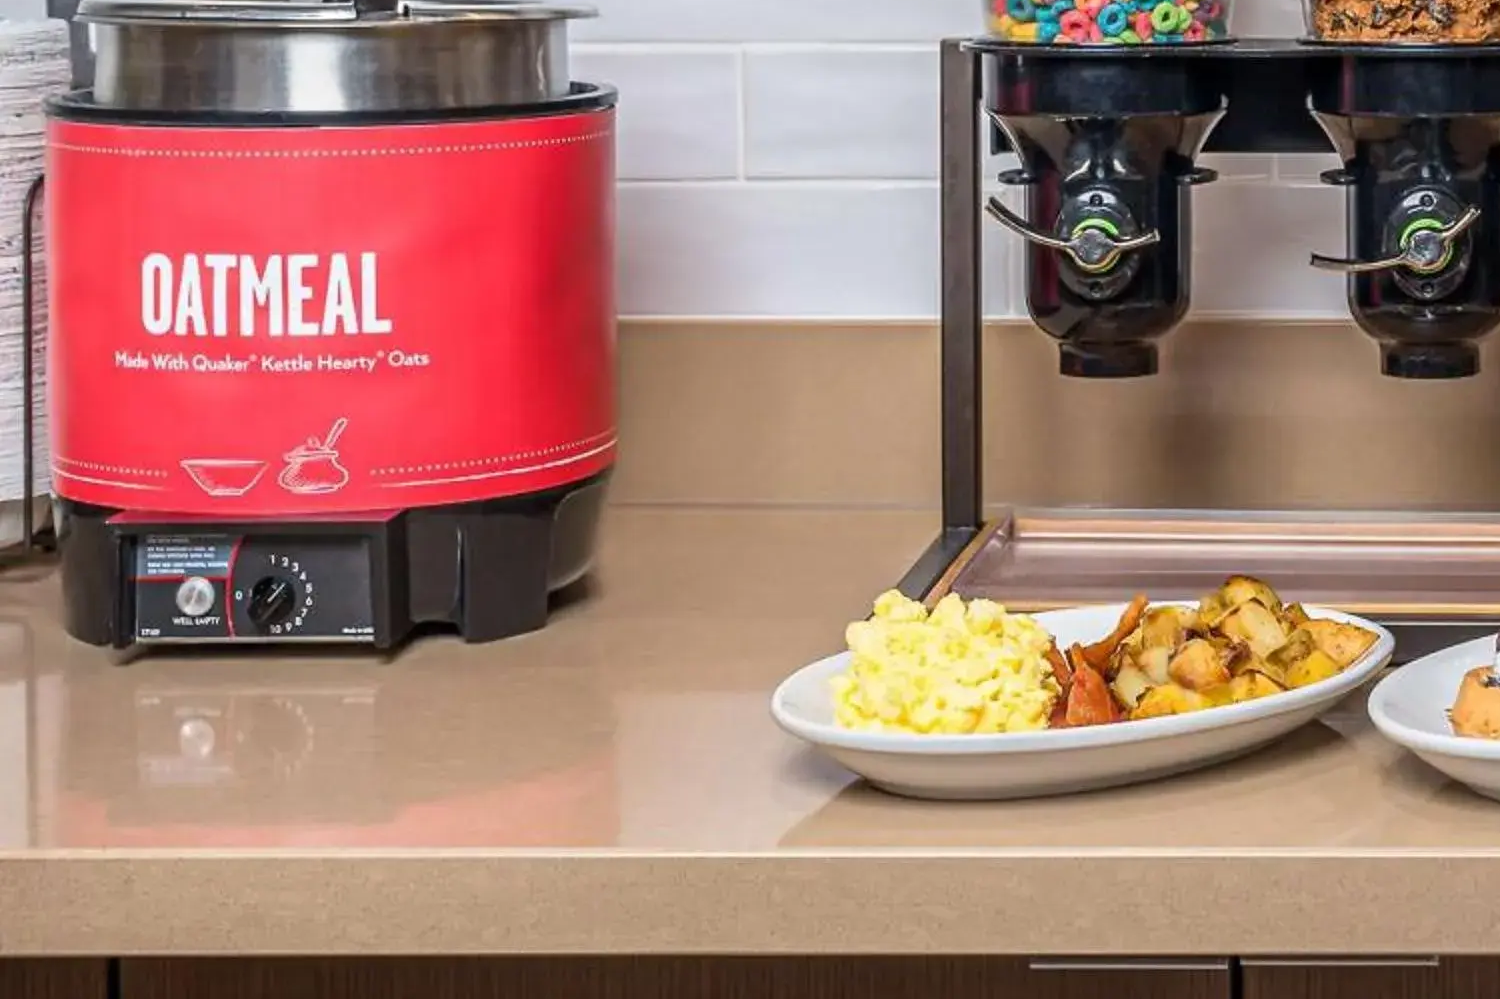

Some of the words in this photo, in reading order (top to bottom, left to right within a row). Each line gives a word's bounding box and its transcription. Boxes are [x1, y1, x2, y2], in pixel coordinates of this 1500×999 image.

[141, 251, 393, 337] OATMEAL
[115, 351, 149, 369] Made
[152, 353, 189, 371] With
[261, 355, 313, 372] Kettle
[388, 350, 430, 367] Oats
[281, 556, 289, 567] 2
[291, 562, 299, 572] 3
[299, 571, 307, 581] 4
[305, 582, 313, 593] 5
[235, 589, 243, 601] 0
[305, 596, 313, 606] 6
[301, 607, 308, 618] 7
[295, 616, 302, 626] 8
[285, 622, 292, 632] 9
